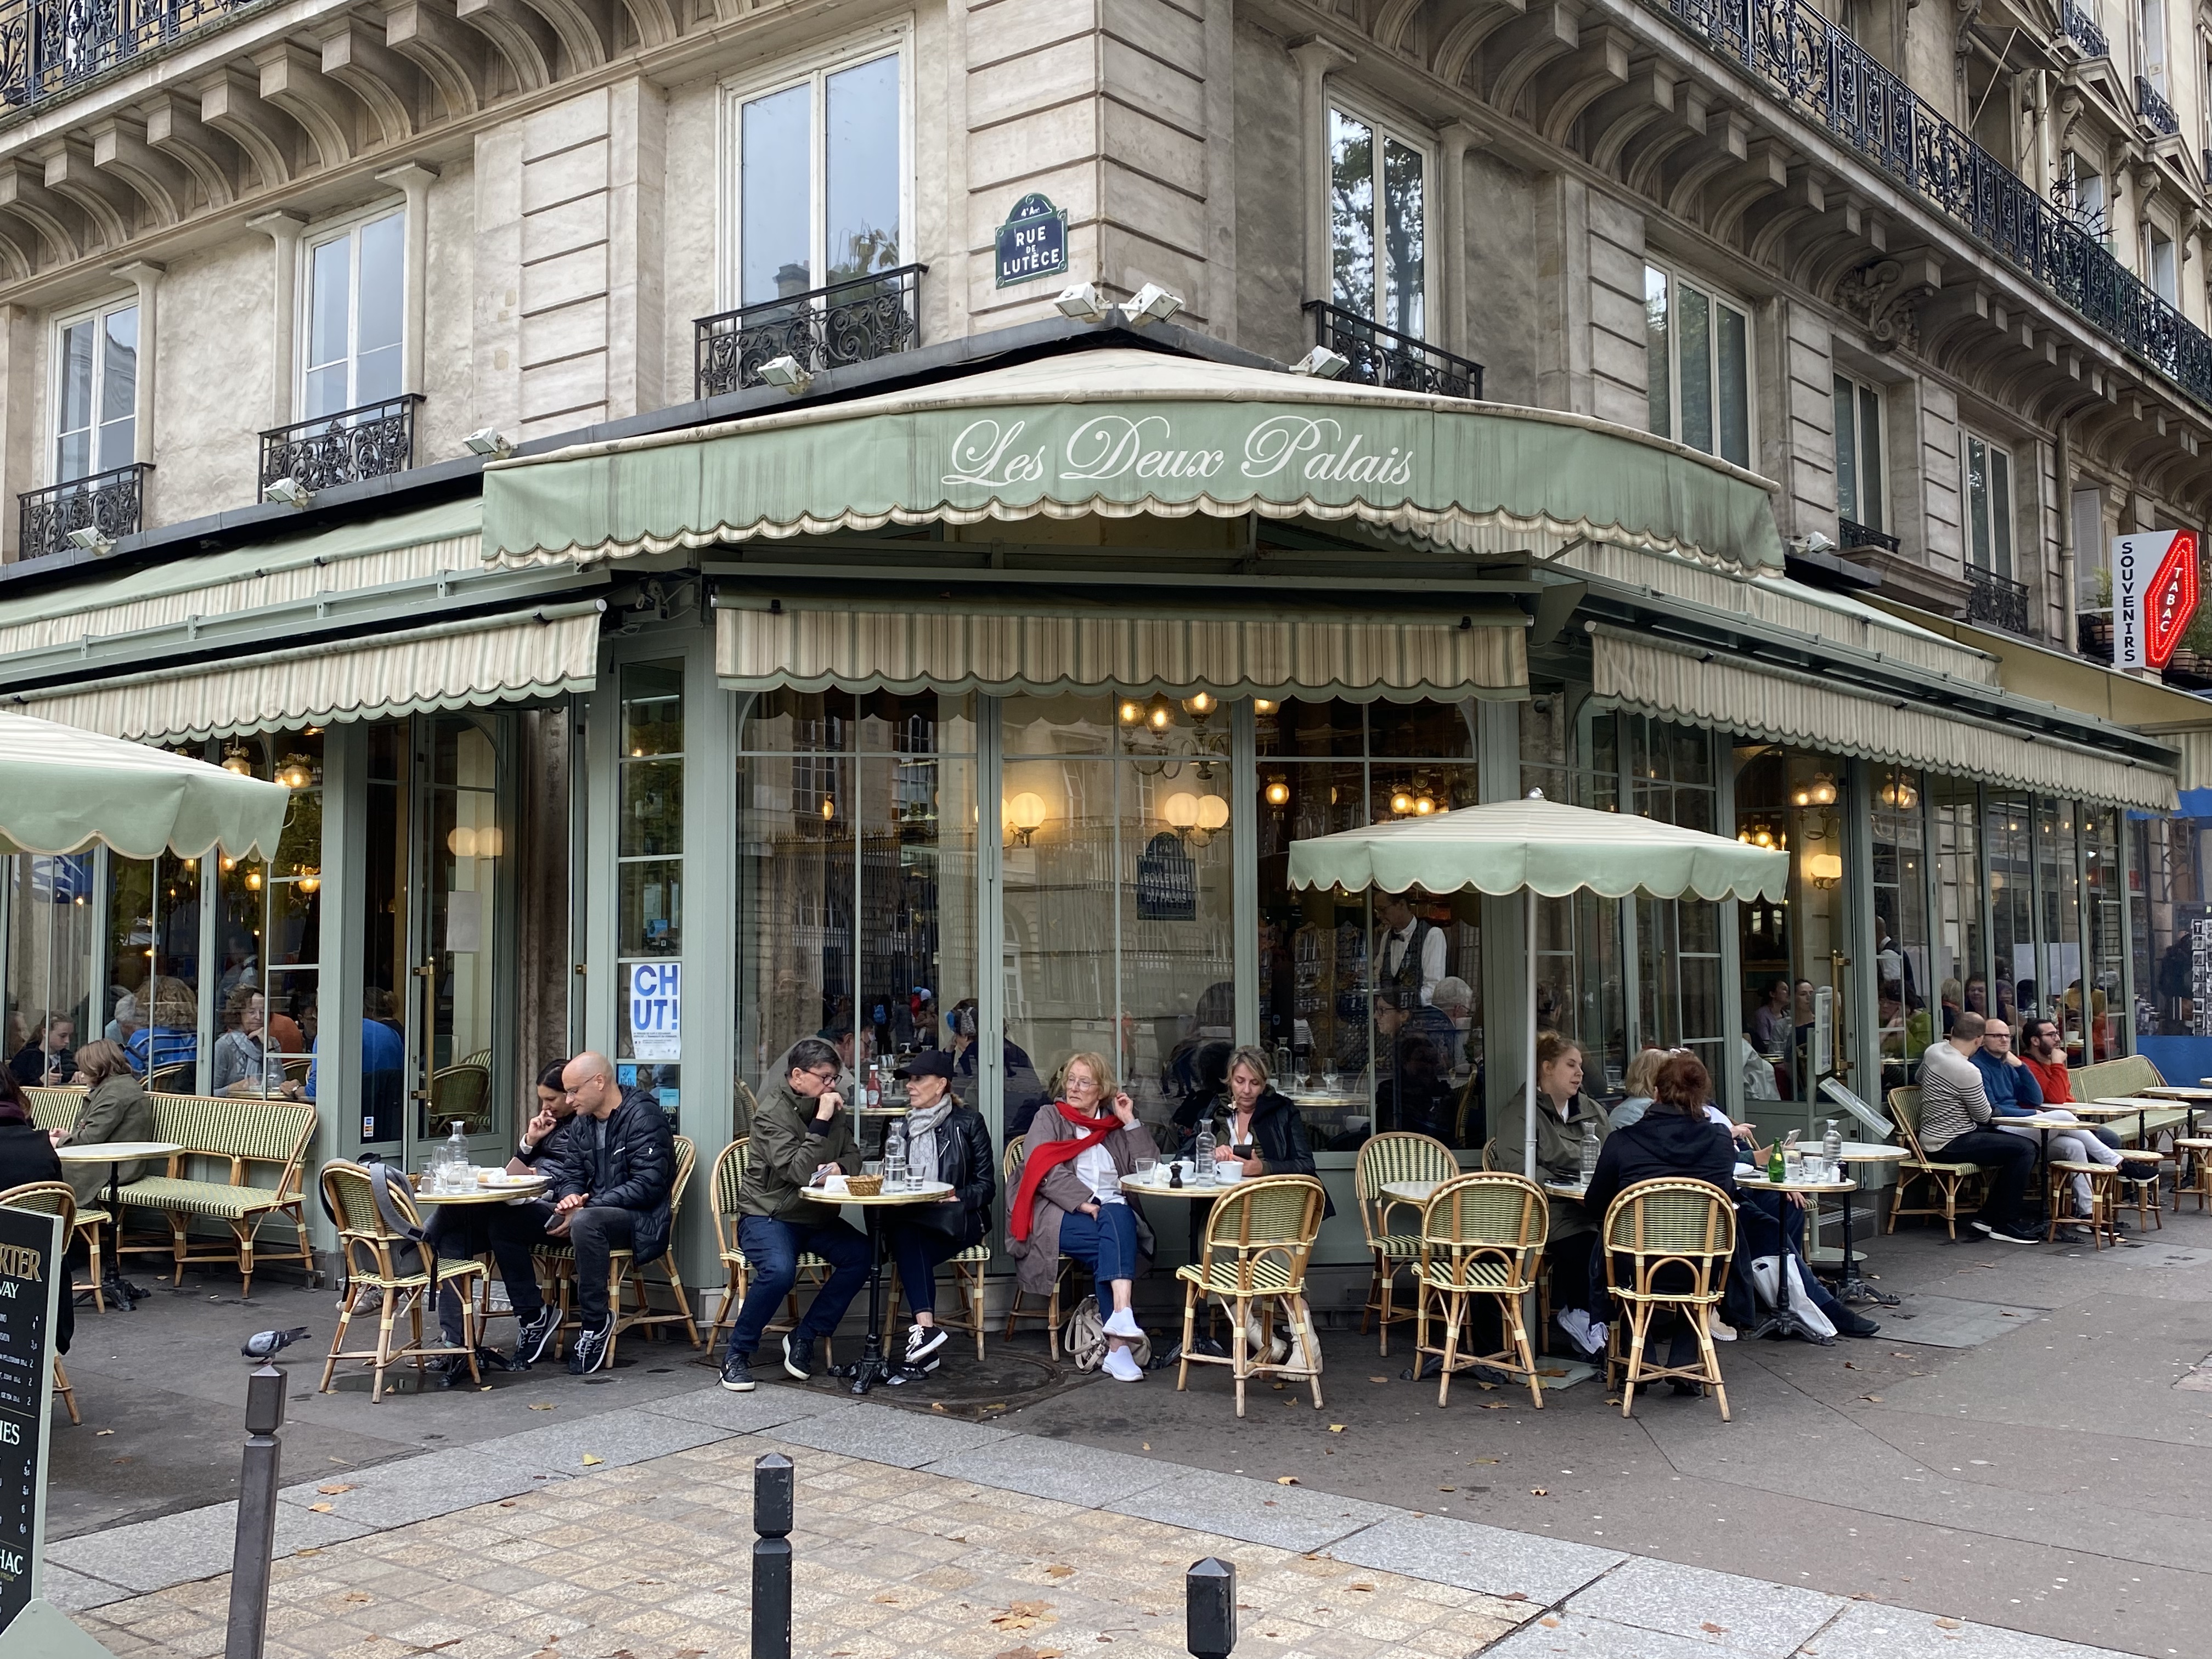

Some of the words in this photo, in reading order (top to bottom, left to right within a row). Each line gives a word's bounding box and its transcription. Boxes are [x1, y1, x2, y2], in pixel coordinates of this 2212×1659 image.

[1016, 226, 1046, 246] RUE
[1026, 245, 1036, 254] DE
[941, 419, 1045, 487] Les
[1059, 415, 1224, 481] Deux
[1240, 415, 1413, 485] Palais
[2120, 542, 2135, 662] SOUVENIRS
[2160, 567, 2183, 632] TABAC
[1144, 872, 1189, 884] BOULEVARD
[1147, 892, 1158, 902] DU
[1160, 893, 1186, 904] PALAIS
[634, 965, 678, 996] CH
[634, 1000, 678, 1030] UT!
[30, 1358, 33, 1368] 2
[27, 1396, 31, 1406] 2
